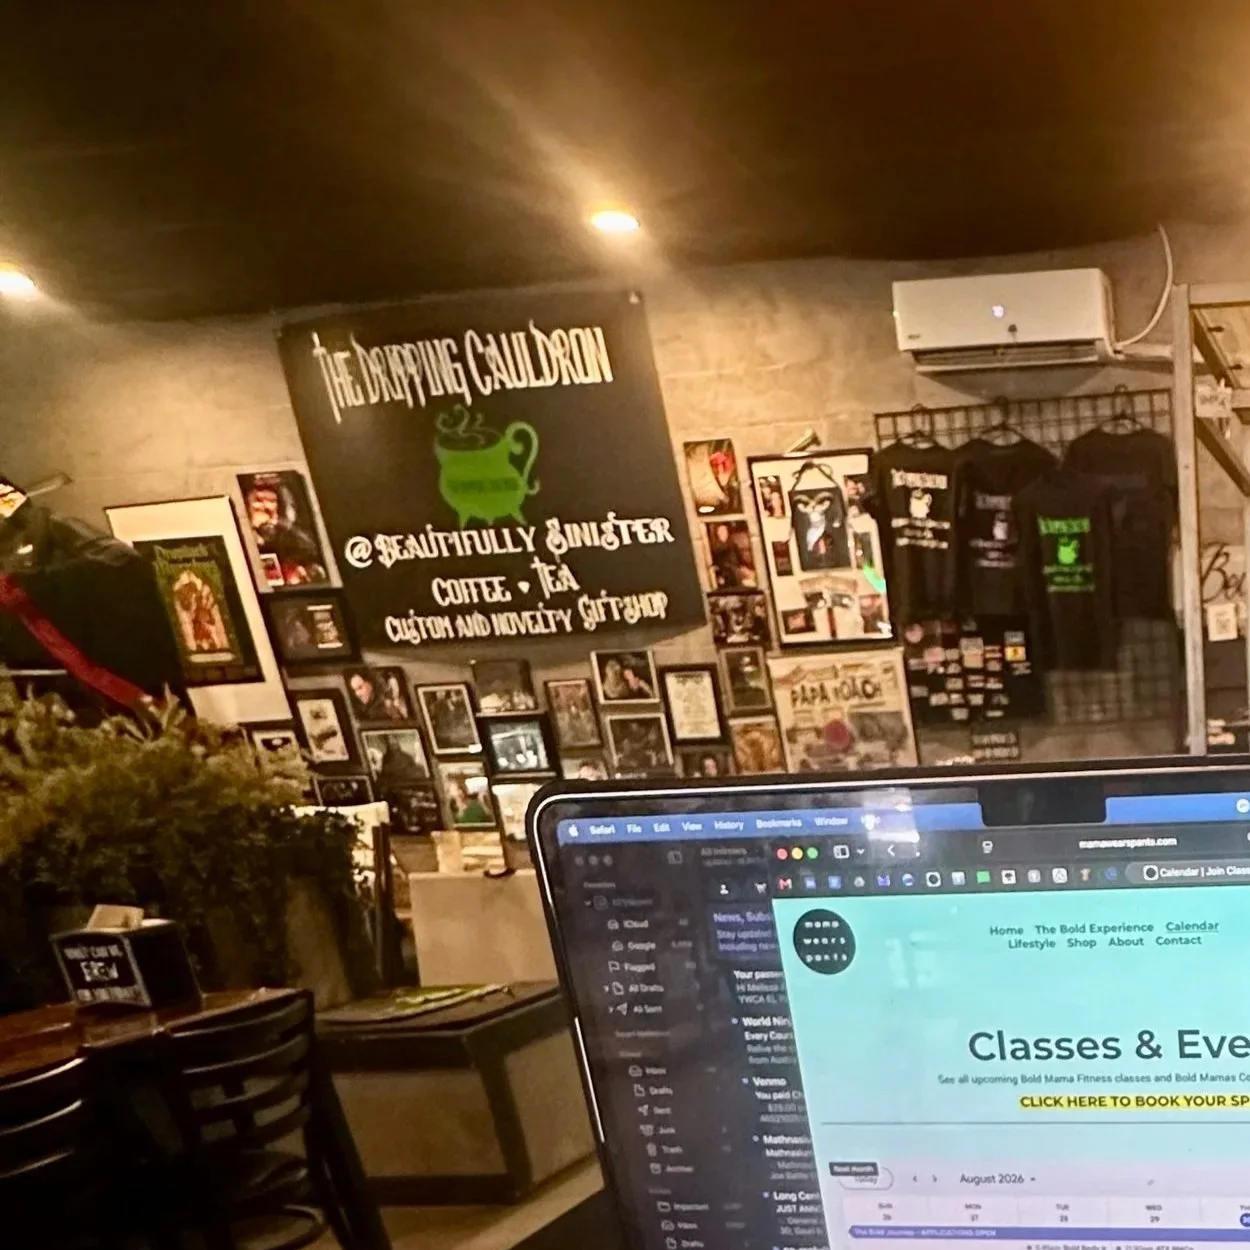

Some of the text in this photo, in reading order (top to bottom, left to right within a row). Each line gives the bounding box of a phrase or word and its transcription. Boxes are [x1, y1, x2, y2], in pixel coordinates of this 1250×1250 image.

[312, 319, 613, 424] THE DRIPPING CAULDRON
[546, 512, 675, 556] SINISTER
[432, 556, 580, 606] COFFEE TEA
[385, 609, 455, 645] CUSTOM
[456, 610, 491, 638] AND
[491, 602, 572, 636] NOVELTY
[589, 817, 848, 836] Safari File Edit View History Bookmarks Window
[1160, 867, 1199, 878] Calendar
[1206, 866, 1224, 877] Join
[804, 920, 839, 929] mama
[990, 921, 1219, 936] Home The Bold Experience Calendar
[803, 937, 846, 945] wears
[1008, 935, 1203, 950] Lifestyle Shop About Contact
[806, 954, 848, 963] pants
[742, 1017, 772, 1026] World
[968, 1029, 1122, 1061] Classes
[1135, 1029, 1163, 1060] &
[752, 1077, 787, 1087] Venmo
[938, 1074, 956, 1084] See
[958, 1073, 970, 1083] all
[971, 1074, 1019, 1086] upcoming
[1021, 1073, 1042, 1083] Bold
[1044, 1073, 1075, 1083] Mama
[1077, 1073, 1113, 1083] Fitness
[1114, 1072, 1151, 1083] classes
[1154, 1072, 1173, 1082] and
[1175, 1072, 1197, 1082] Bold
[1200, 1072, 1236, 1082] Mamas
[755, 1091, 772, 1100] You
[1020, 1096, 1064, 1108] CLICK
[1067, 1096, 1108, 1107] HERE
[1109, 1096, 1131, 1107] TO
[1135, 1095, 1181, 1107] BOOK
[1183, 1095, 1227, 1107] YOUR
[960, 1174, 1024, 1186] August 2026
[773, 1191, 797, 1202] Long
